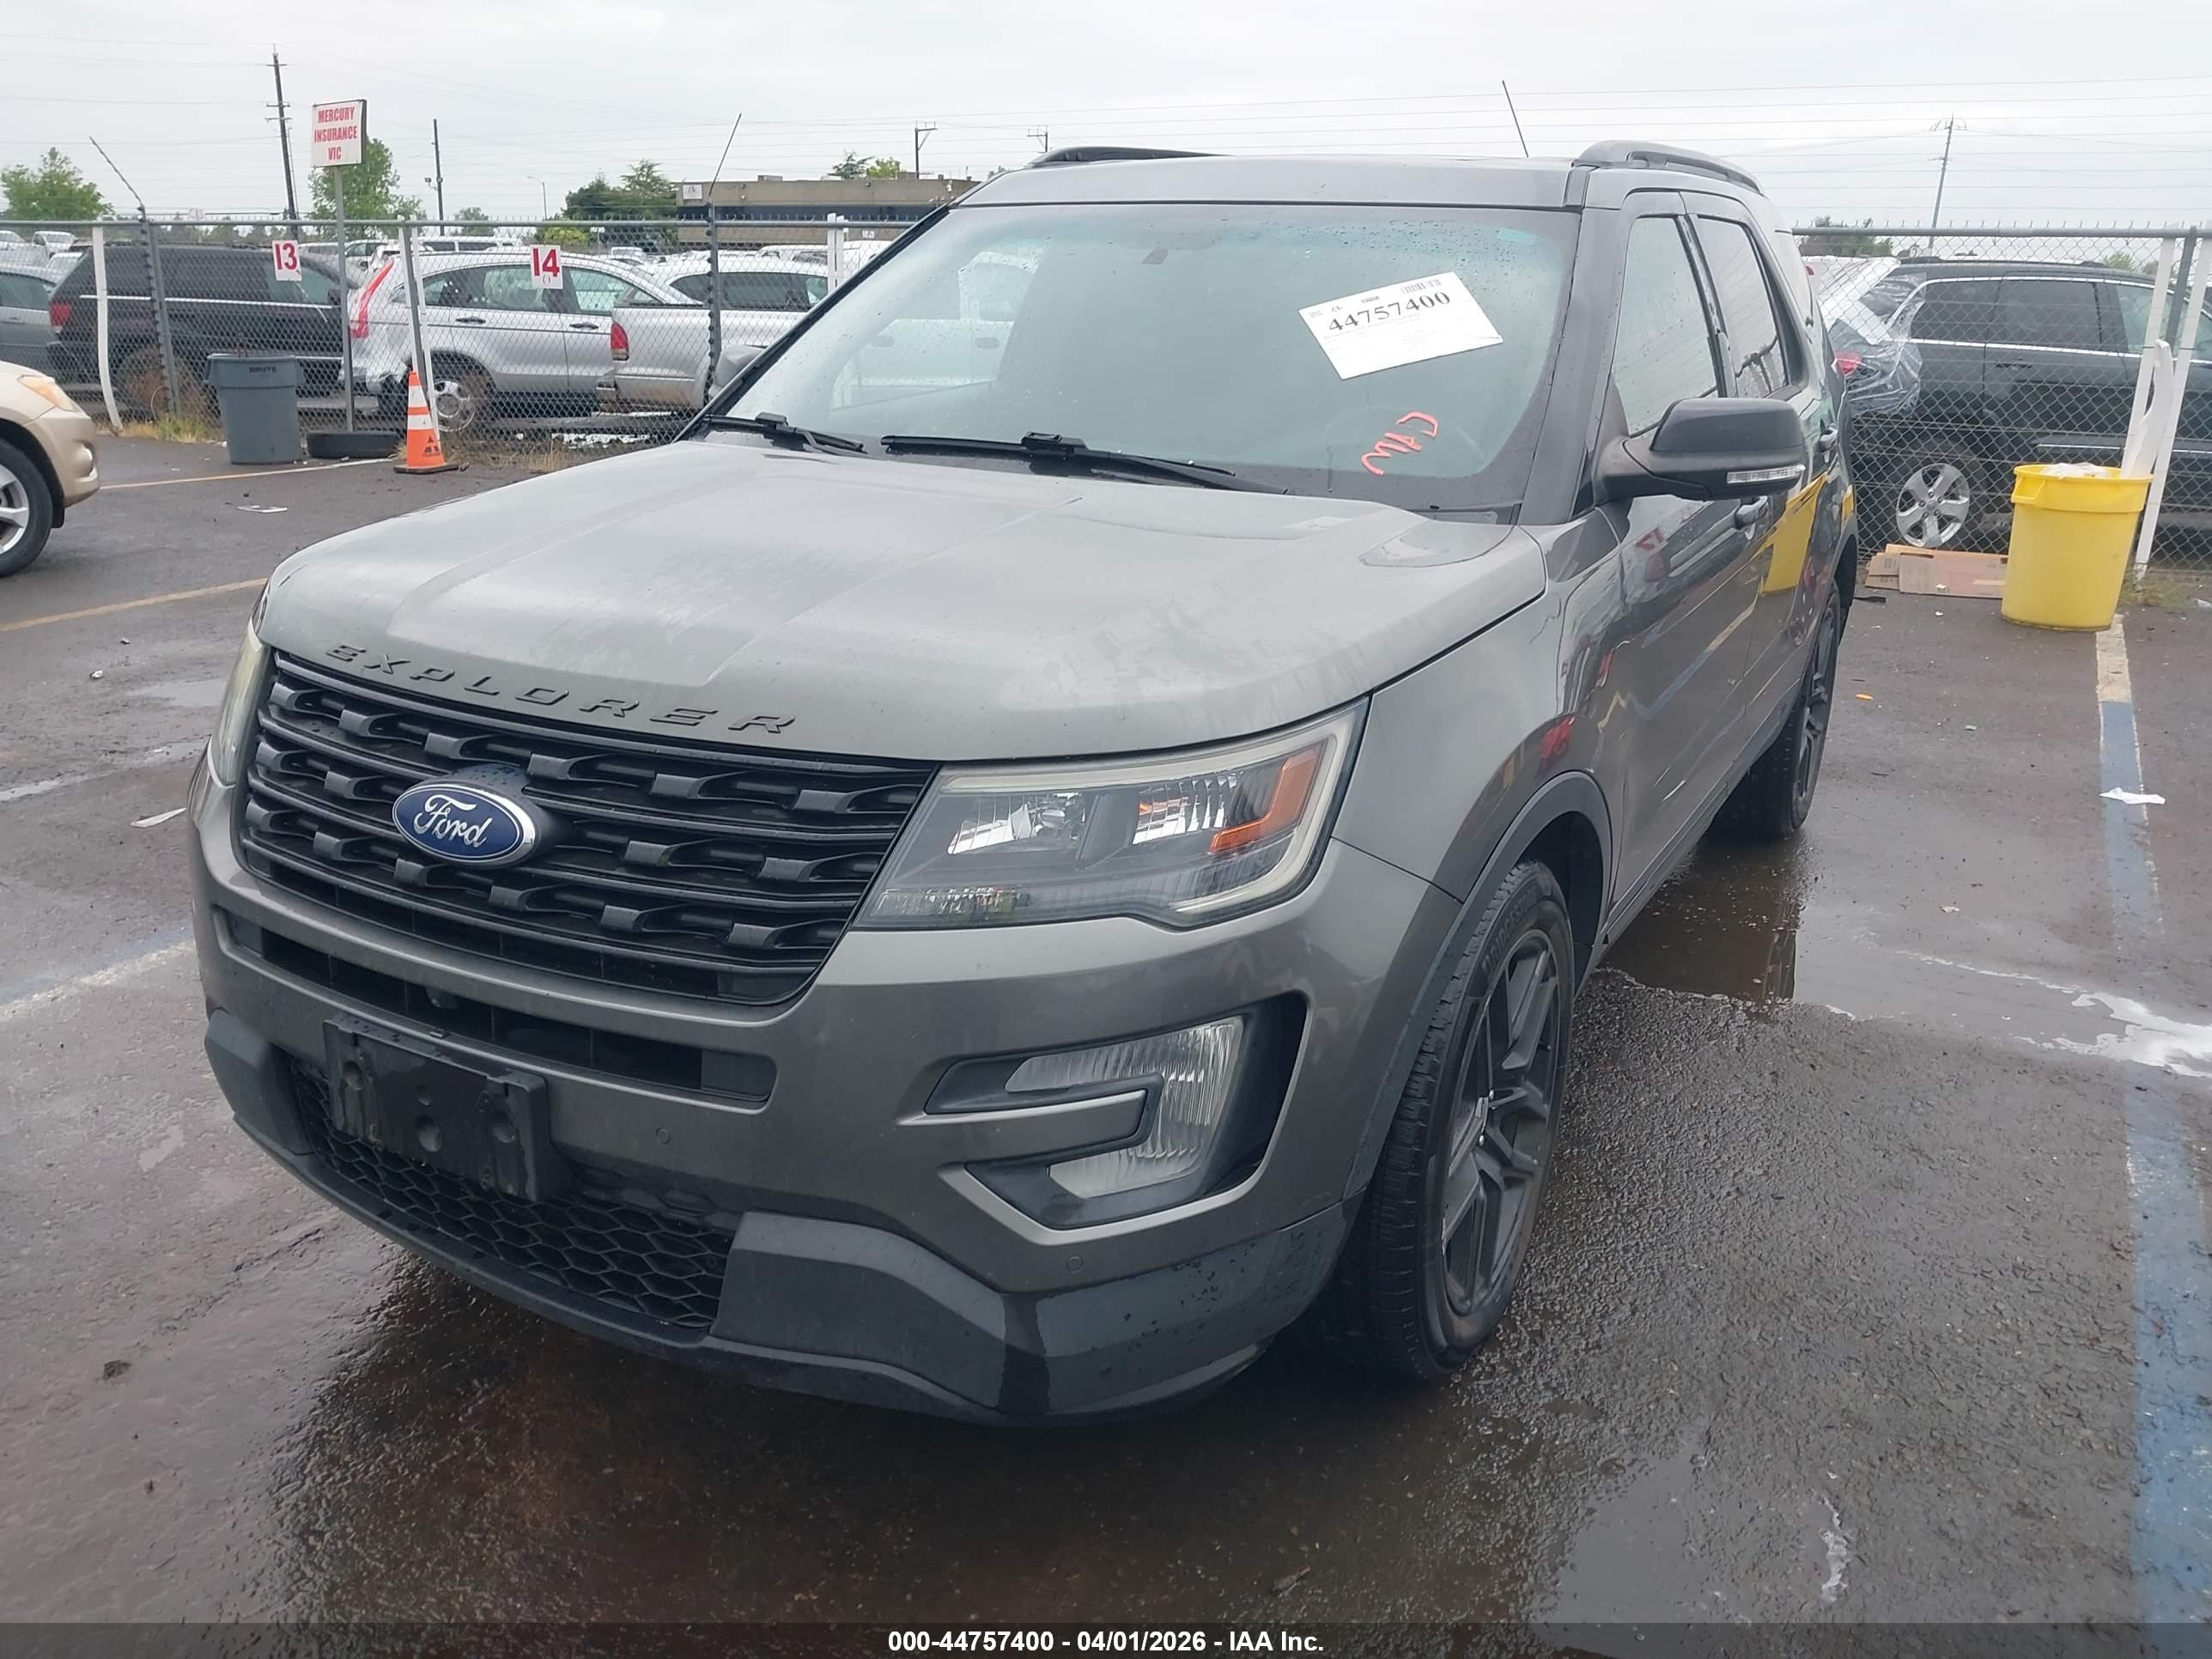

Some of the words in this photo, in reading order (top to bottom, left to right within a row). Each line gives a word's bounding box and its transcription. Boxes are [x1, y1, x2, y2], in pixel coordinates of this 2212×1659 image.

[318, 106, 356, 124] MERCURY
[313, 125, 358, 143] INSURANCE
[328, 146, 342, 161] VIC
[275, 242, 298, 270] 13
[532, 247, 561, 277] 14
[1328, 290, 1451, 331] 44757400
[325, 644, 796, 734] EXPLORER
[413, 793, 494, 848] Ford
